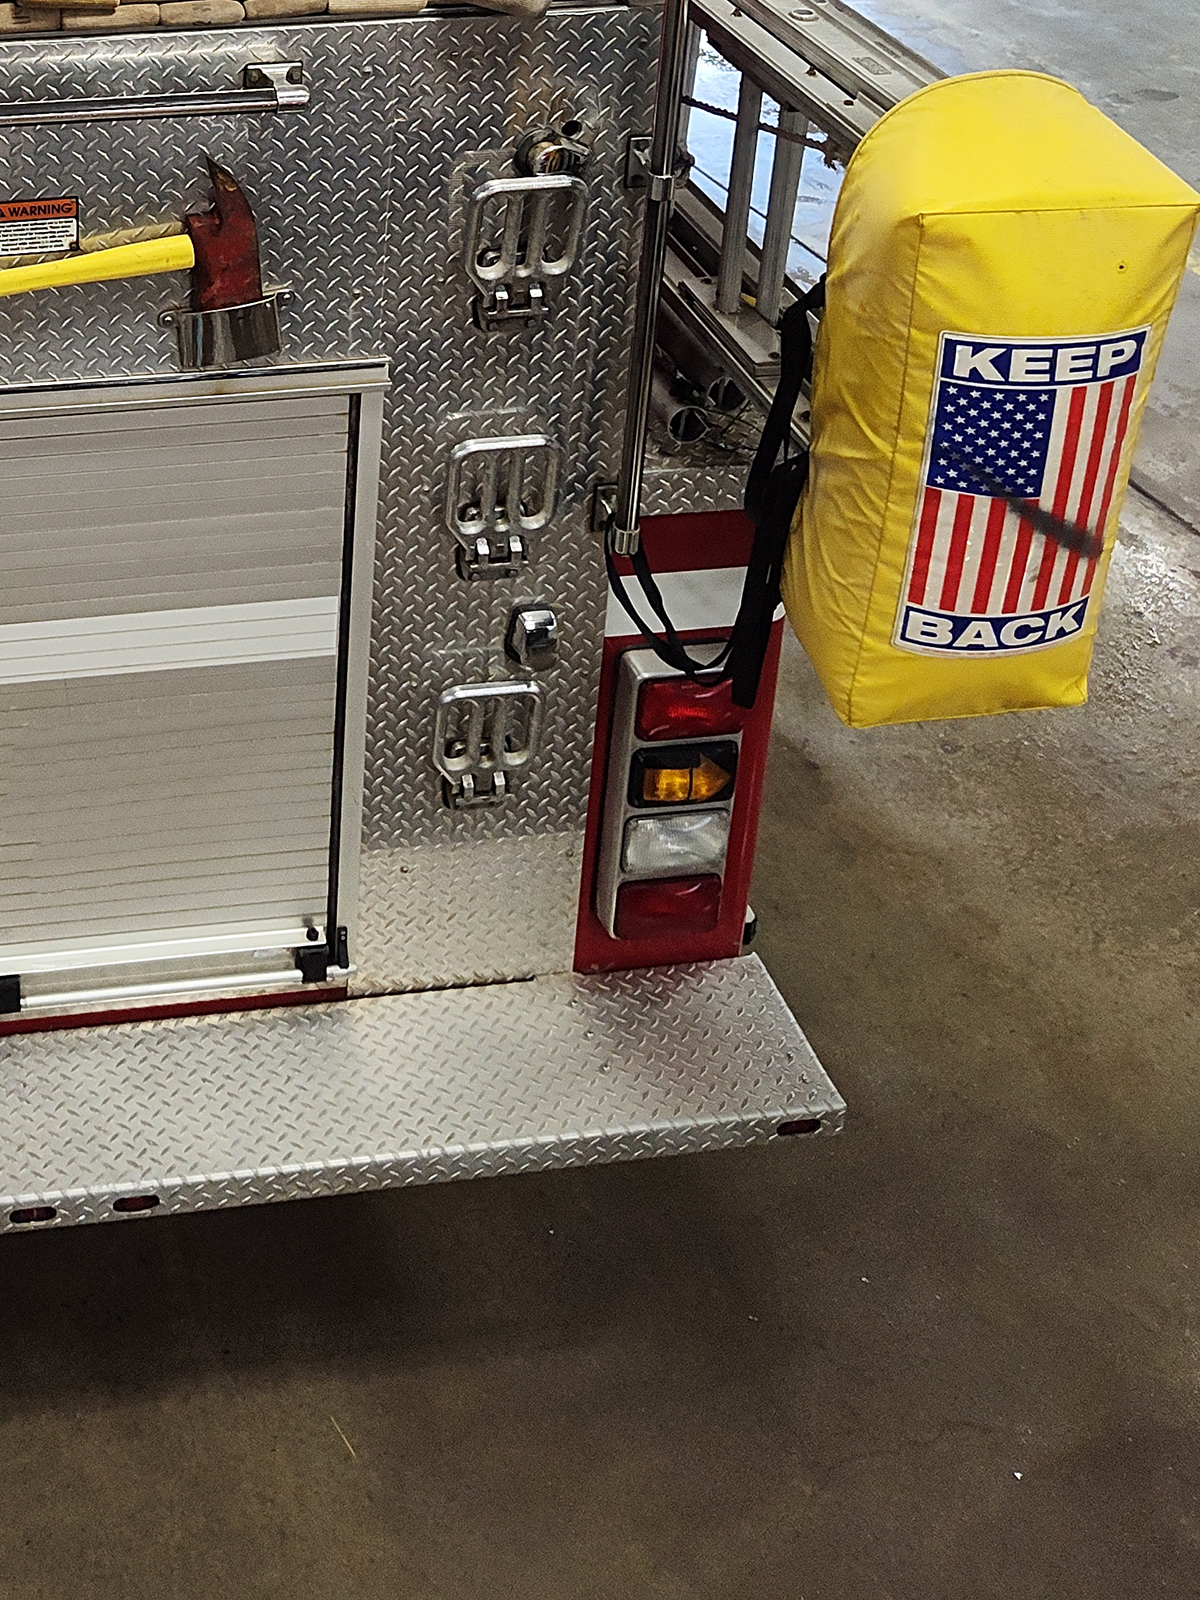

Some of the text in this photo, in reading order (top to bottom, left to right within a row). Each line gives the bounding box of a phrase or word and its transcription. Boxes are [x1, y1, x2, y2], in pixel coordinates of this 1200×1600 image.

[8, 203, 73, 218] WARNING
[952, 339, 1138, 383] KEEP
[905, 606, 1085, 648] BACK
